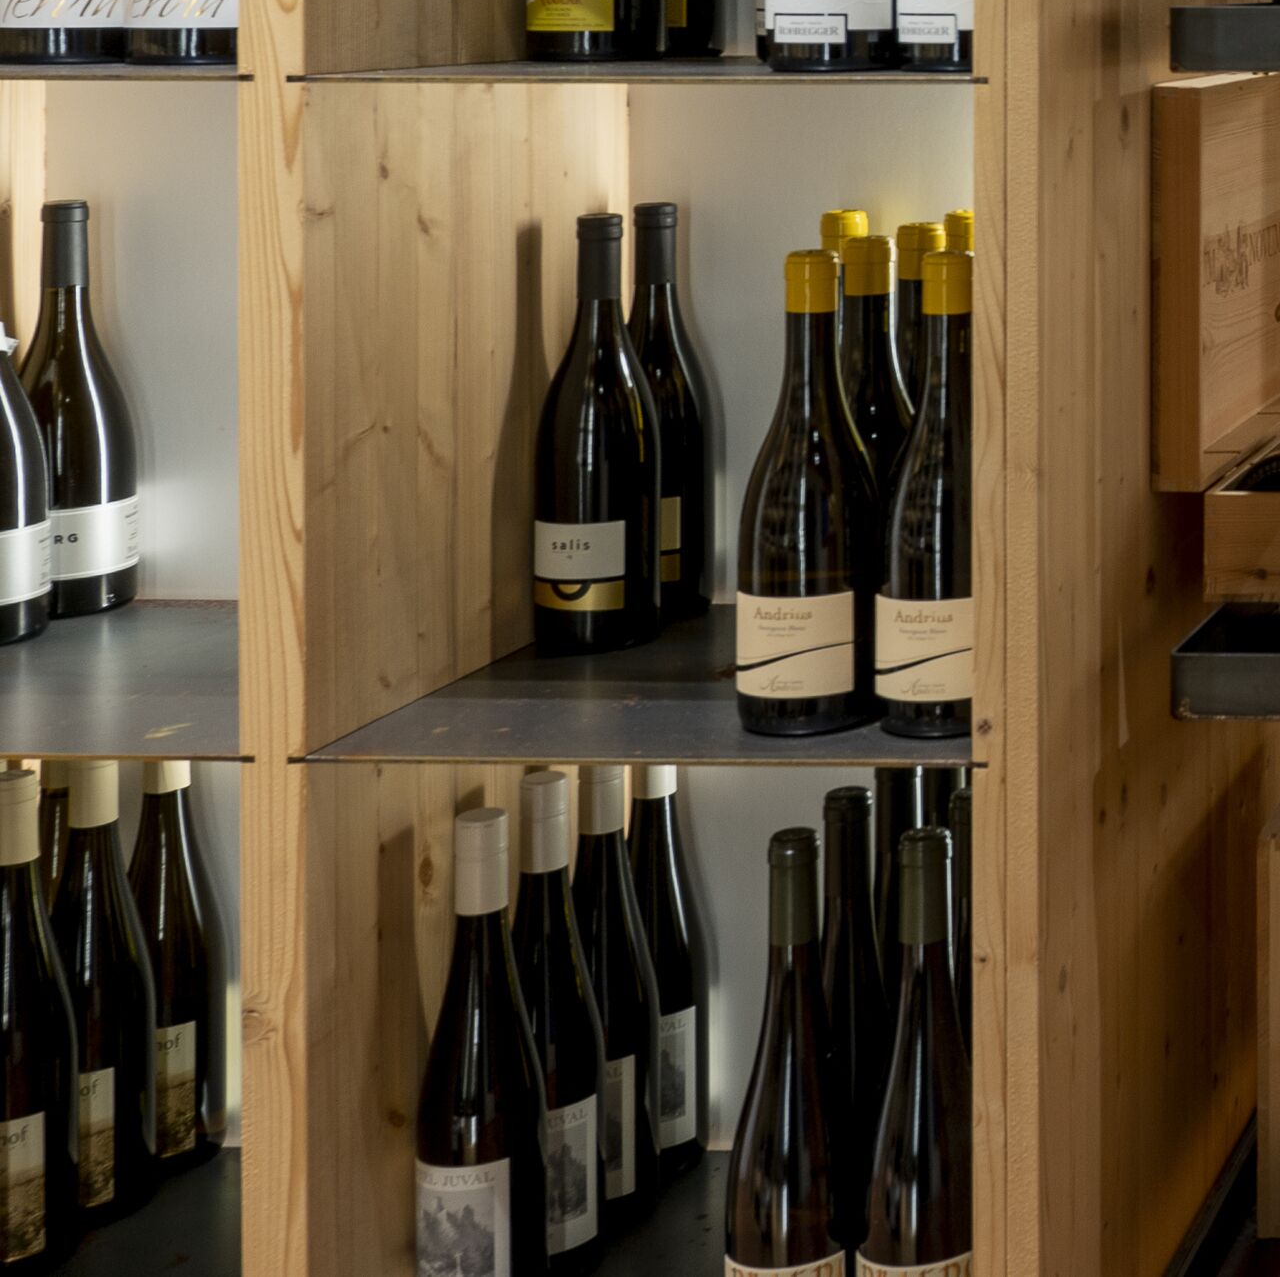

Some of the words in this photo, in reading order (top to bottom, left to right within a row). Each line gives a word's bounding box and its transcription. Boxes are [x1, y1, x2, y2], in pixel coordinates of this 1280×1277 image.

[551, 539, 591, 551] salis
[753, 607, 812, 621] Andrius
[893, 609, 953, 624] Andrius
